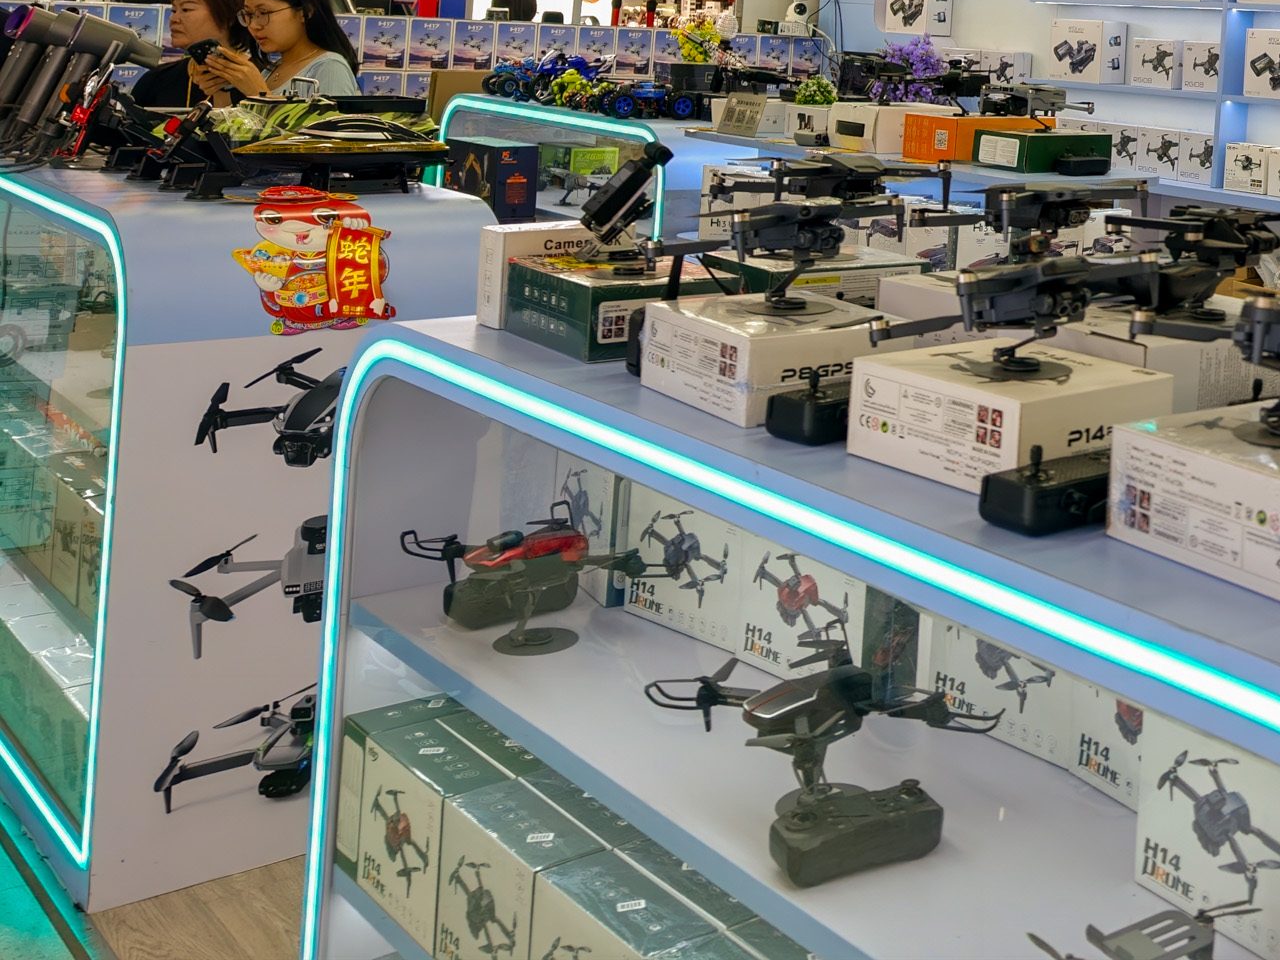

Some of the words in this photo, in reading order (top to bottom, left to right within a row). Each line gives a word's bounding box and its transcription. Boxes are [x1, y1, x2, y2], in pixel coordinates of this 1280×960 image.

[337, 234, 371, 299] 蛇年
[745, 623, 772, 645] H14
[1080, 733, 1111, 762] H14
[1144, 837, 1181, 872] H14
